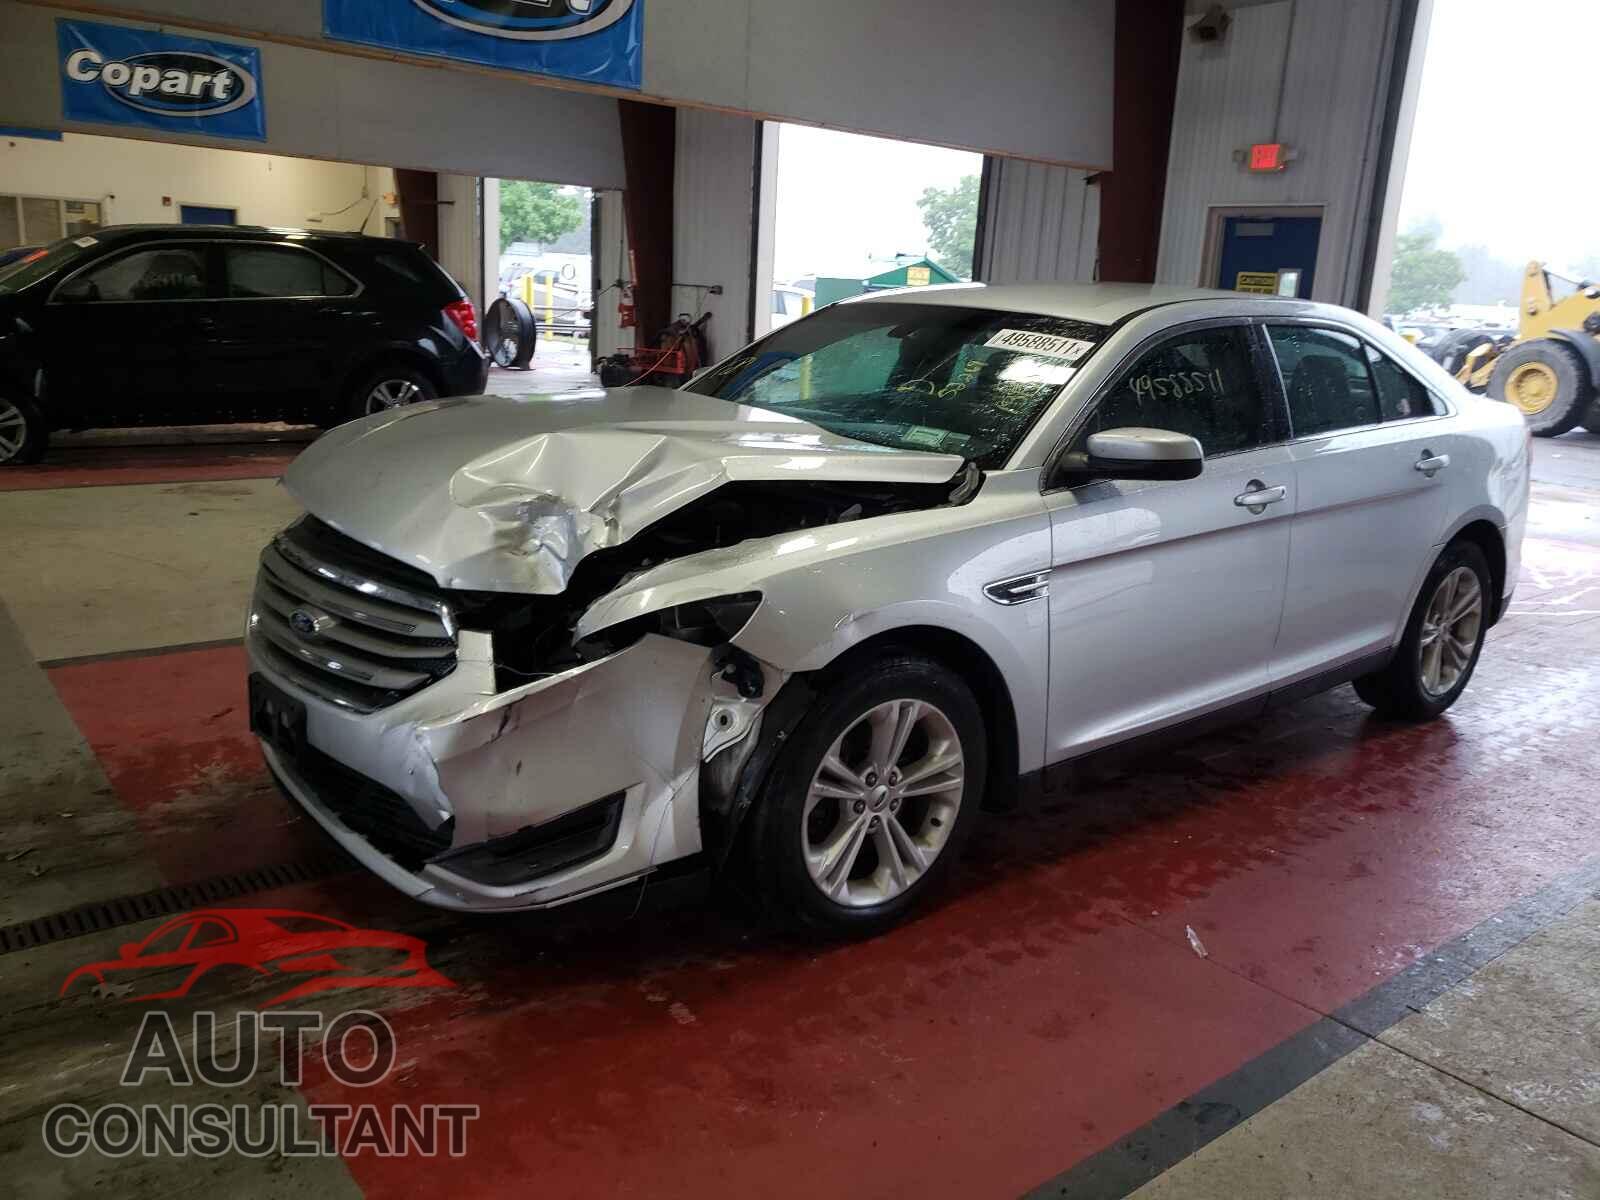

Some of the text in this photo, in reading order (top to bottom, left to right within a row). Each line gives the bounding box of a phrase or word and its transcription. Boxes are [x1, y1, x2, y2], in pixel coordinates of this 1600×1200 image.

[65, 49, 233, 101] Copart
[1002, 331, 1078, 355] 49588511
[1128, 368, 1225, 407] 49588511
